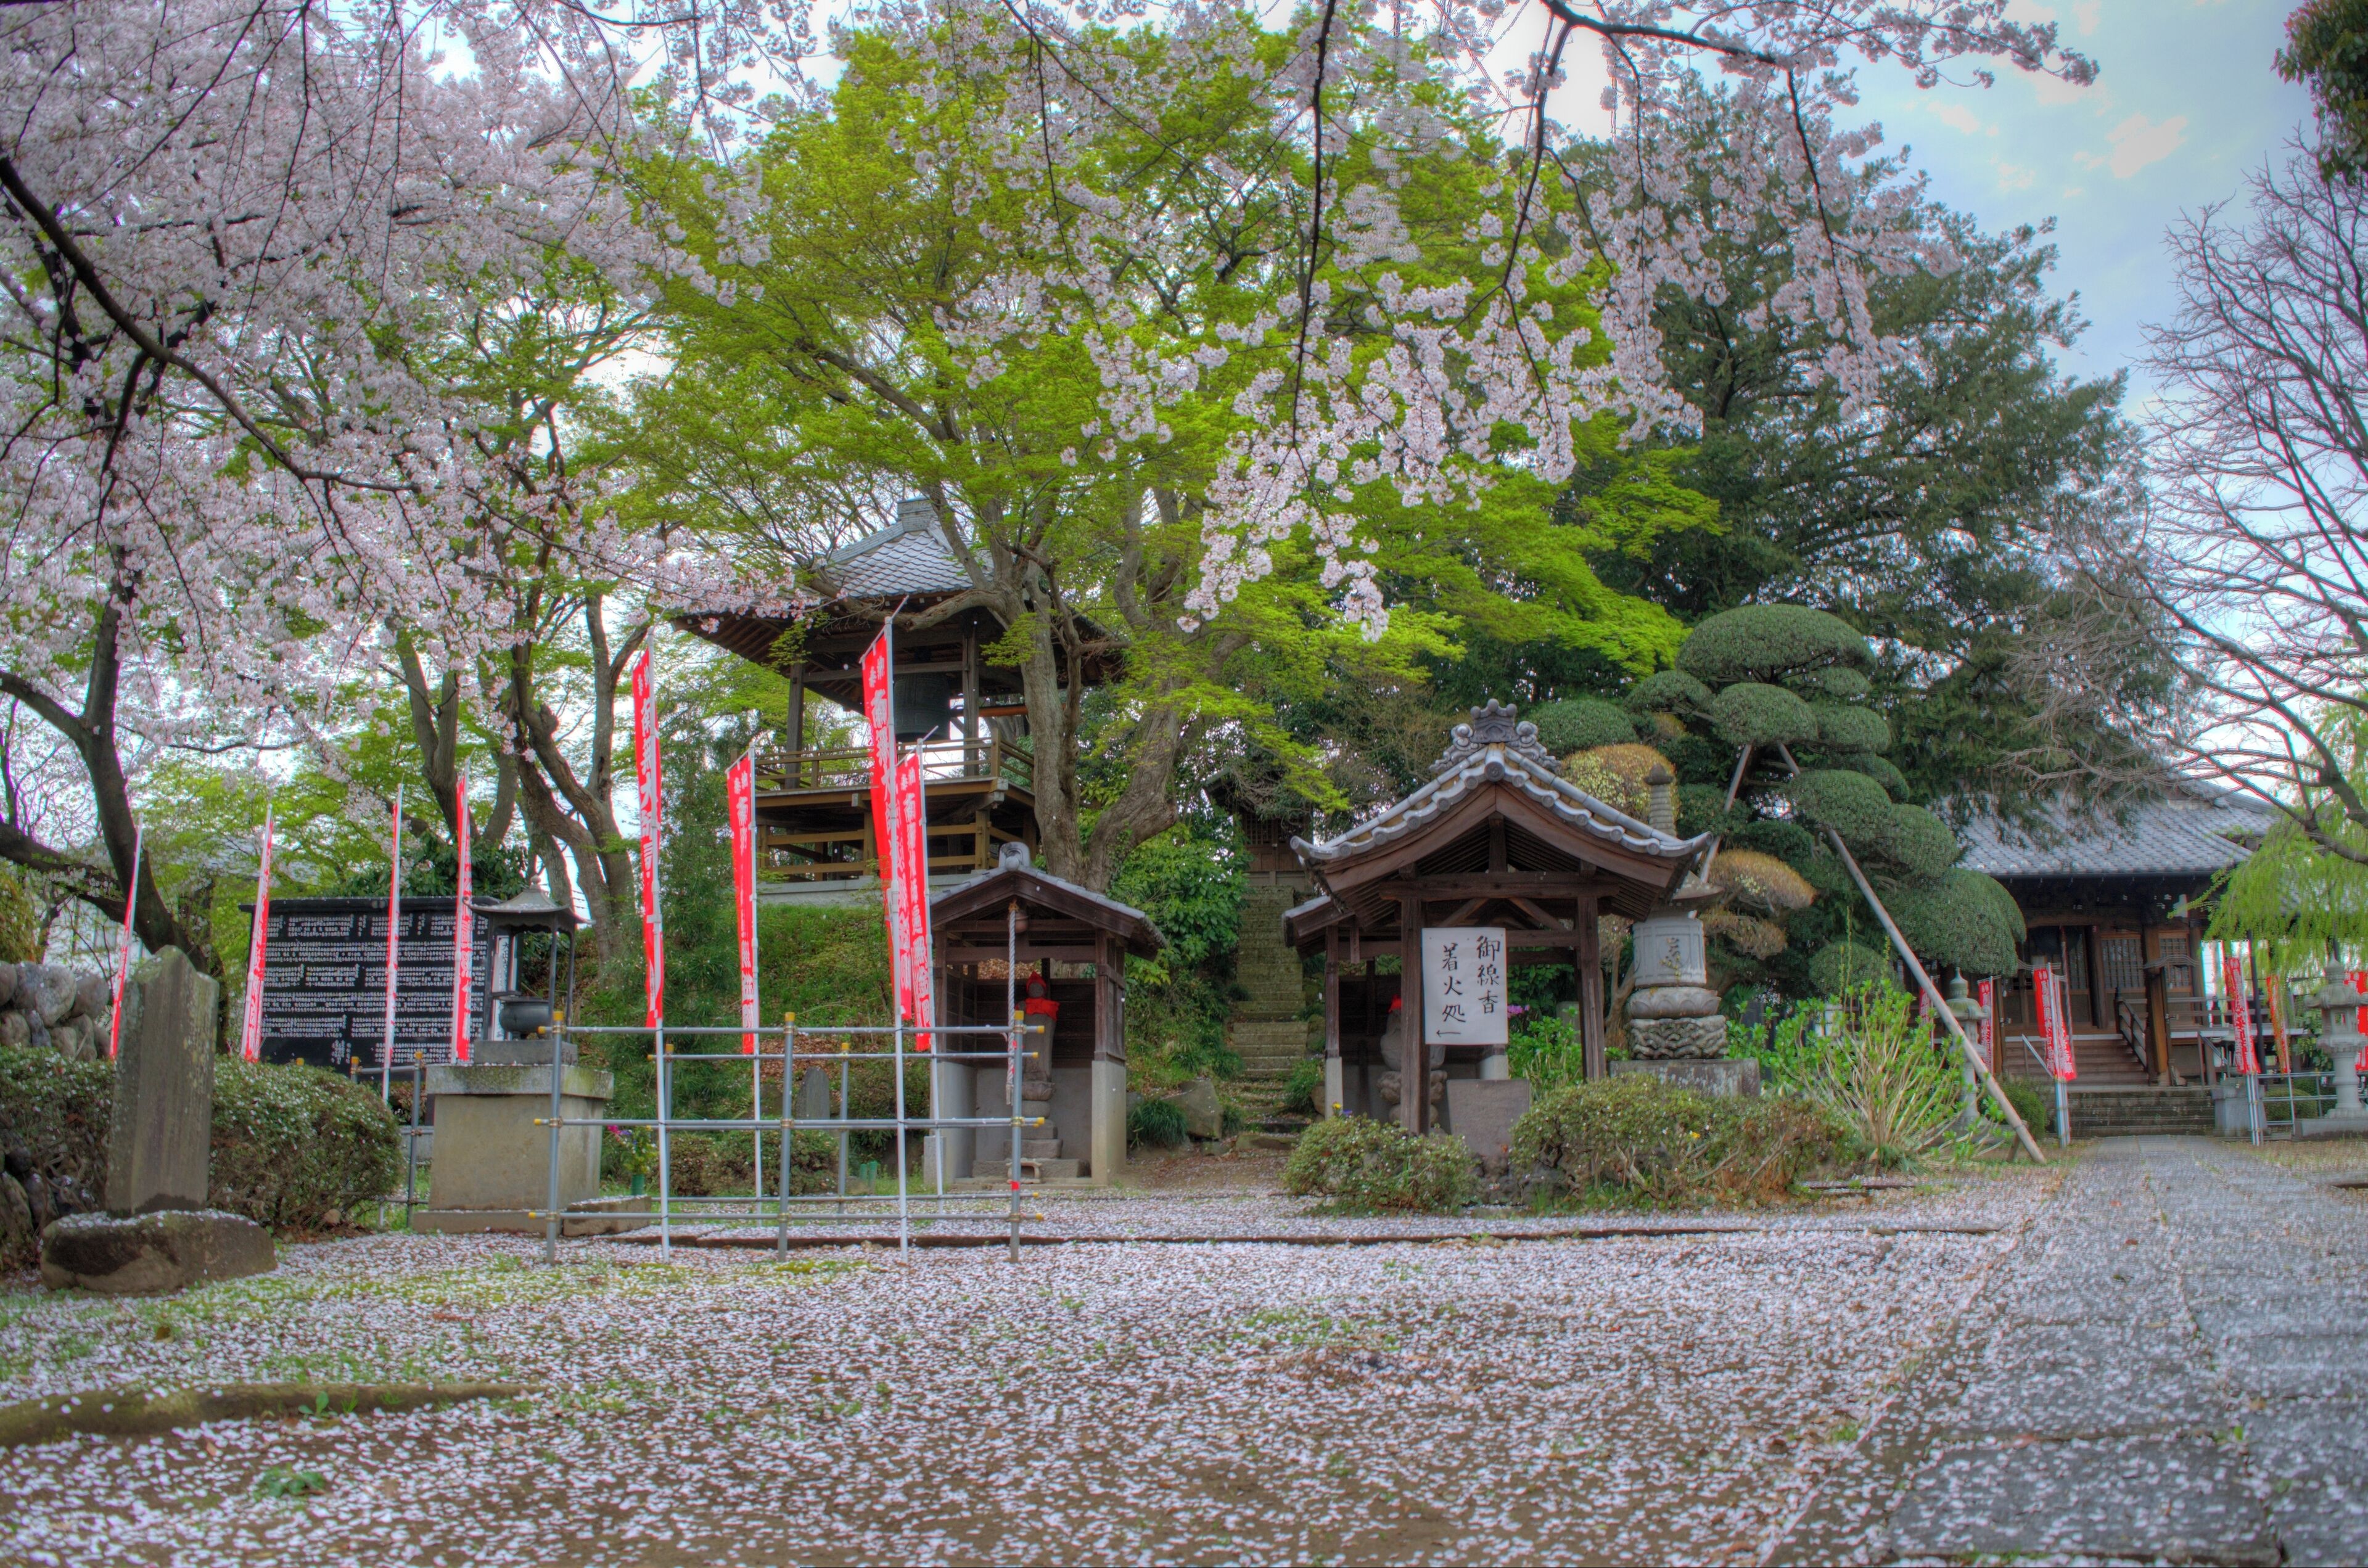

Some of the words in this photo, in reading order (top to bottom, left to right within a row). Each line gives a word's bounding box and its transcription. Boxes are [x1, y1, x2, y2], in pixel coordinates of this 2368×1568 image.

[1441, 942, 1466, 1022] 着火処
[1476, 936, 1500, 1013] 御線香
